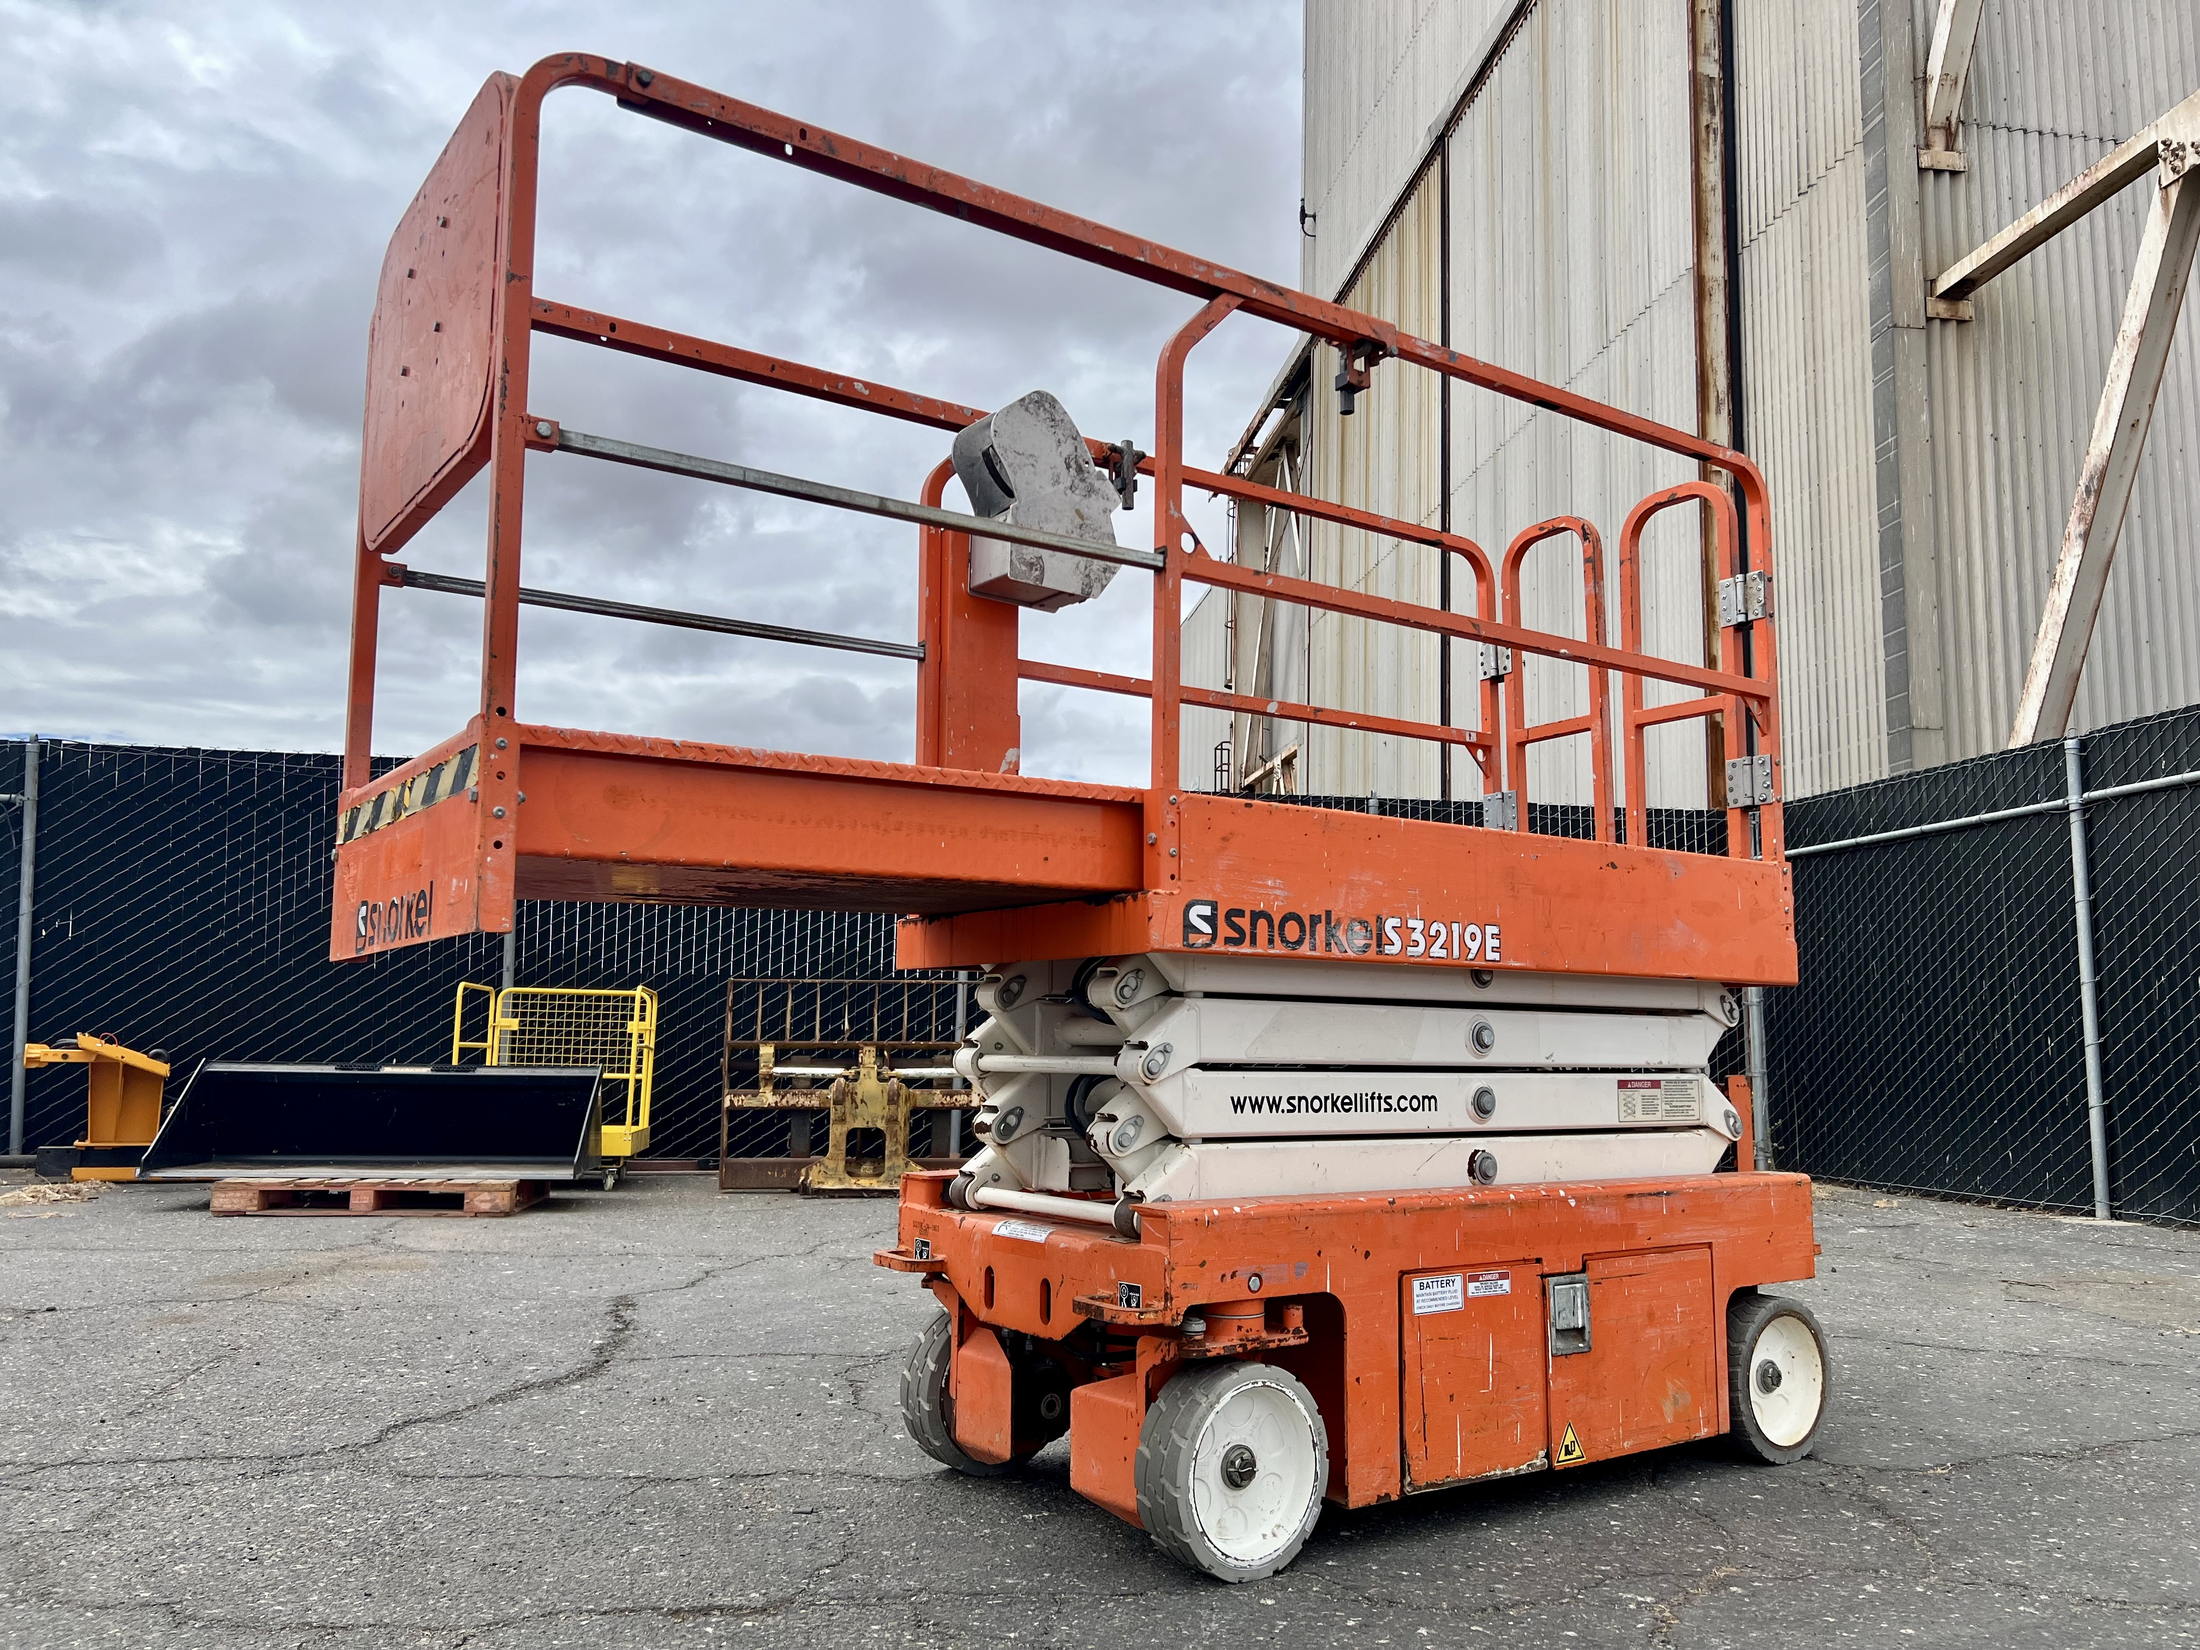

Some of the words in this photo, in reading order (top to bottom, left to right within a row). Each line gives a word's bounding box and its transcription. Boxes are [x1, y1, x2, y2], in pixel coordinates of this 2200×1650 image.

[1224, 905, 1384, 955] snorkel
[1382, 916, 1502, 962] S3219E
[1229, 1091, 1438, 1114] www.snorkellifts.com
[1419, 1278, 1456, 1291] BATTERY
